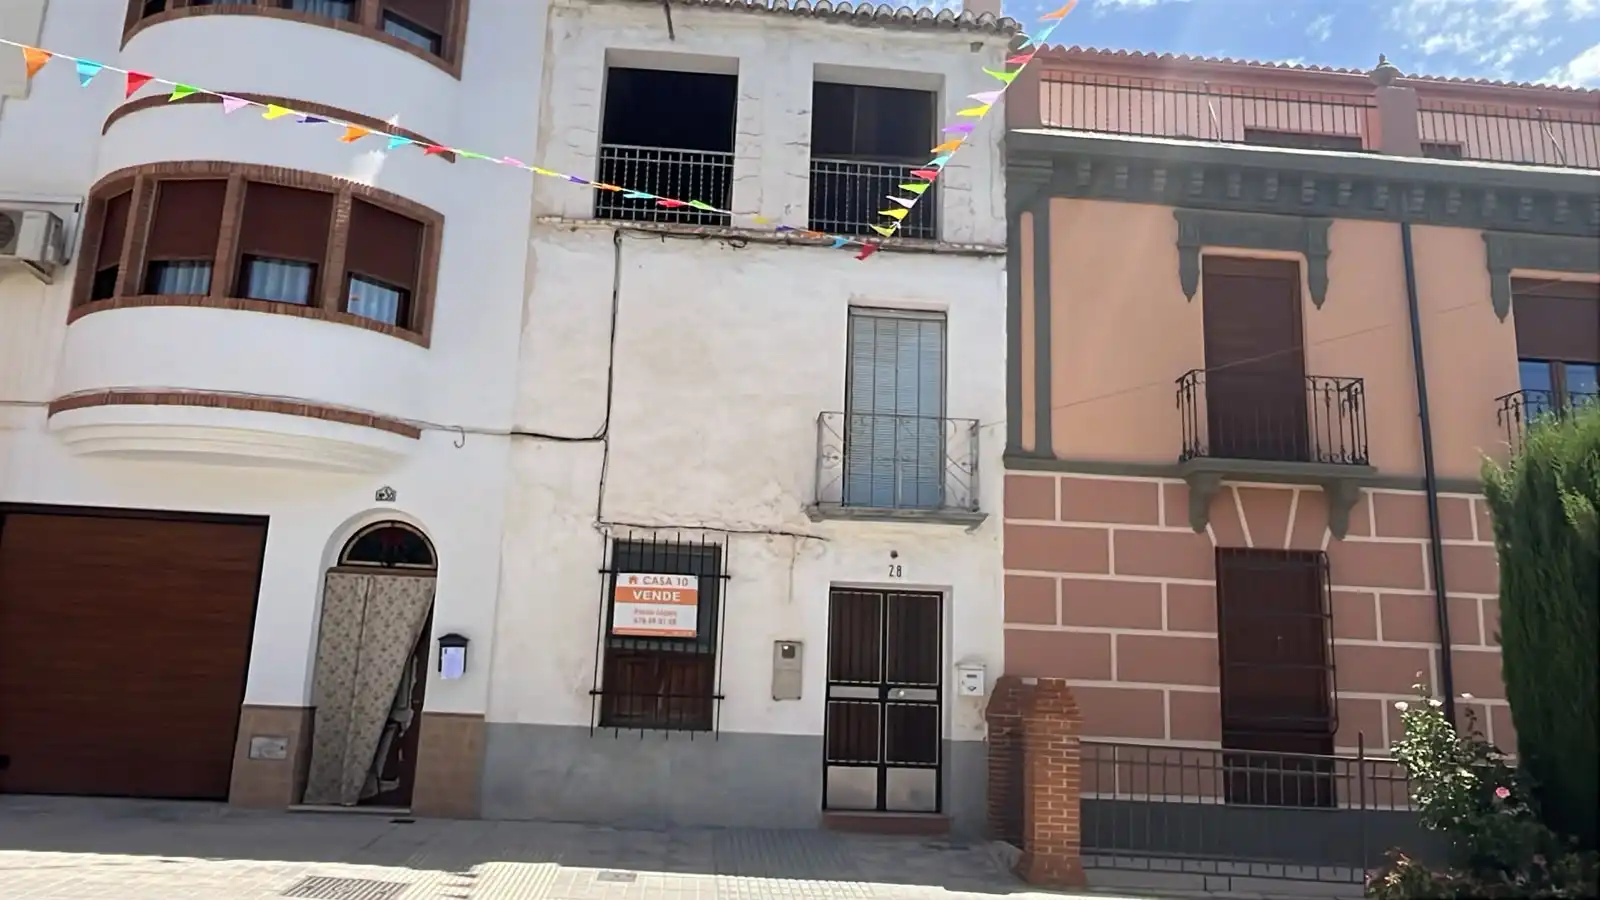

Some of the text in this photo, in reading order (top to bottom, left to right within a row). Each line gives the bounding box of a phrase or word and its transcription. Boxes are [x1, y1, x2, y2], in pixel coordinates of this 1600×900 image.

[889, 564, 902, 577] 28
[642, 575, 689, 587] CASA 10
[632, 589, 681, 602] VENDE
